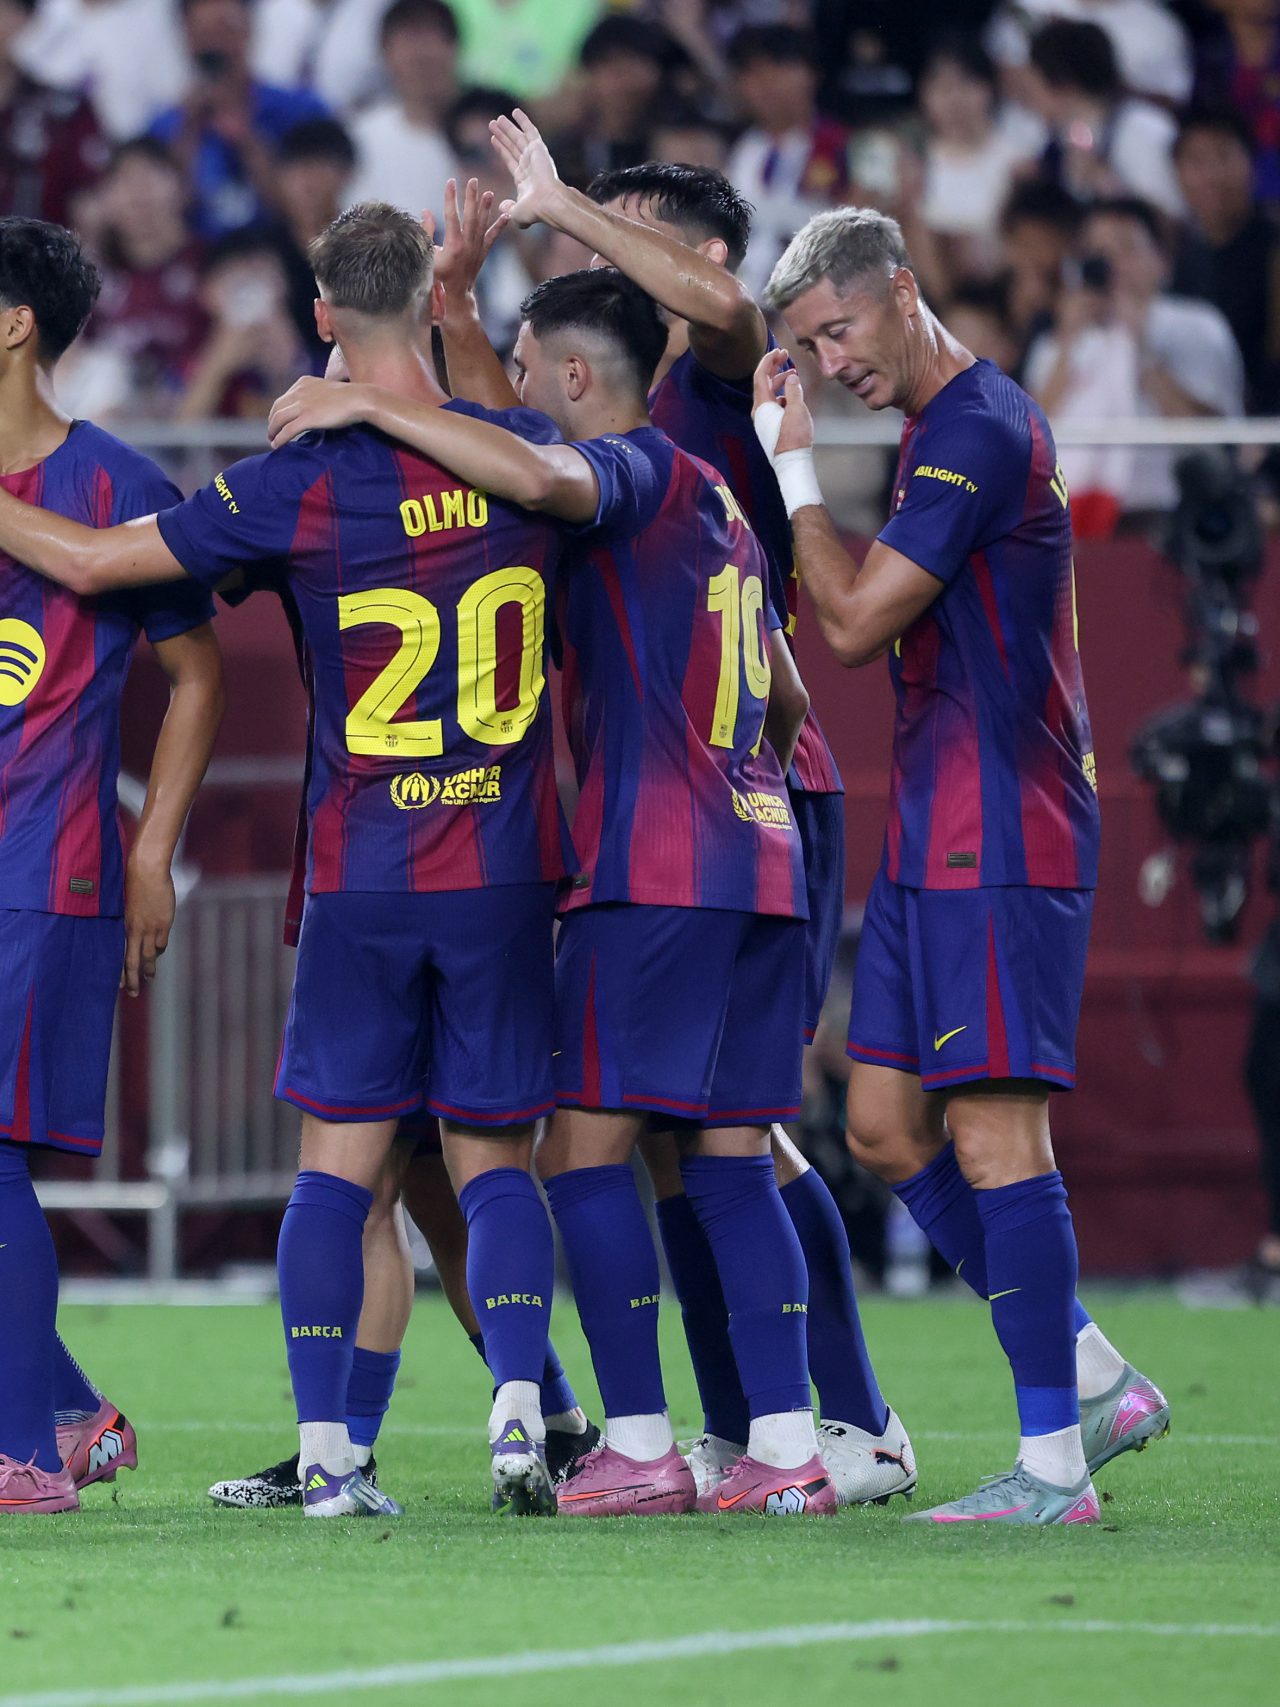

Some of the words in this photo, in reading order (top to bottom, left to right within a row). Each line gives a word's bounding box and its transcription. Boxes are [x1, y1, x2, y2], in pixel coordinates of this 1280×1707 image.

[214, 472, 233, 501] LIGHT
[914, 465, 966, 487] BILIGHT
[399, 488, 488, 537] OLMO
[338, 566, 546, 756] 20
[485, 1293, 543, 1310] BARÇA
[291, 1325, 342, 1338] BARÇA
